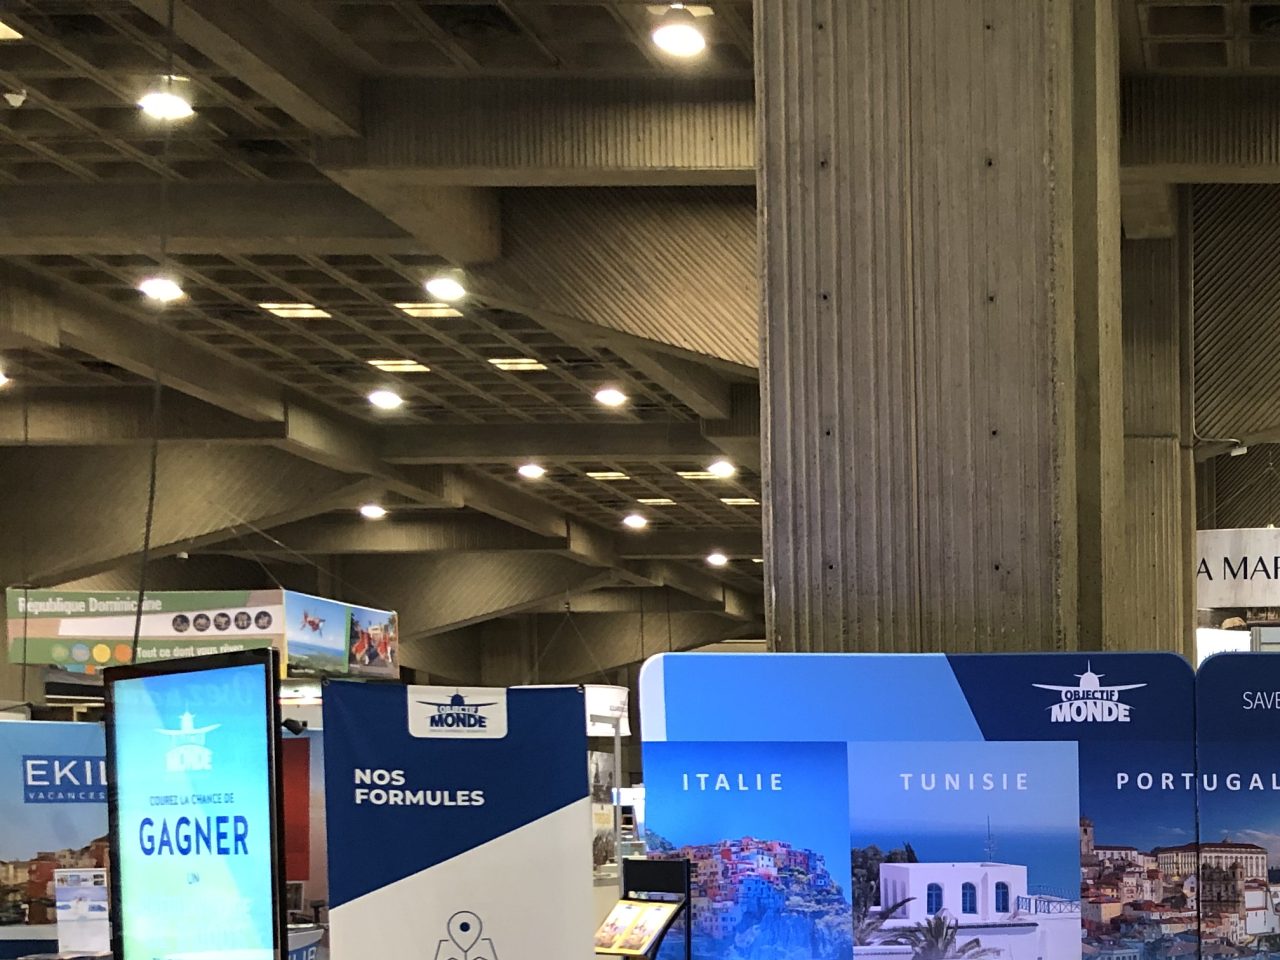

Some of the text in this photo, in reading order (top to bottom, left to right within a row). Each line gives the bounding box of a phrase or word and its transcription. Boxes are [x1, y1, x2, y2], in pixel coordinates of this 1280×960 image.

[18, 597, 162, 615] République Dominicine
[1064, 690, 1116, 700] OBJECTIF
[430, 712, 487, 728] MONDE
[1051, 701, 1130, 722] MONDE
[354, 768, 406, 786] NOS
[683, 773, 782, 790] ITALIE
[900, 773, 1028, 790] TUNISIE
[28, 792, 105, 800] VACANCES
[355, 788, 485, 806] FORMULES
[139, 815, 249, 856] GAGNER
